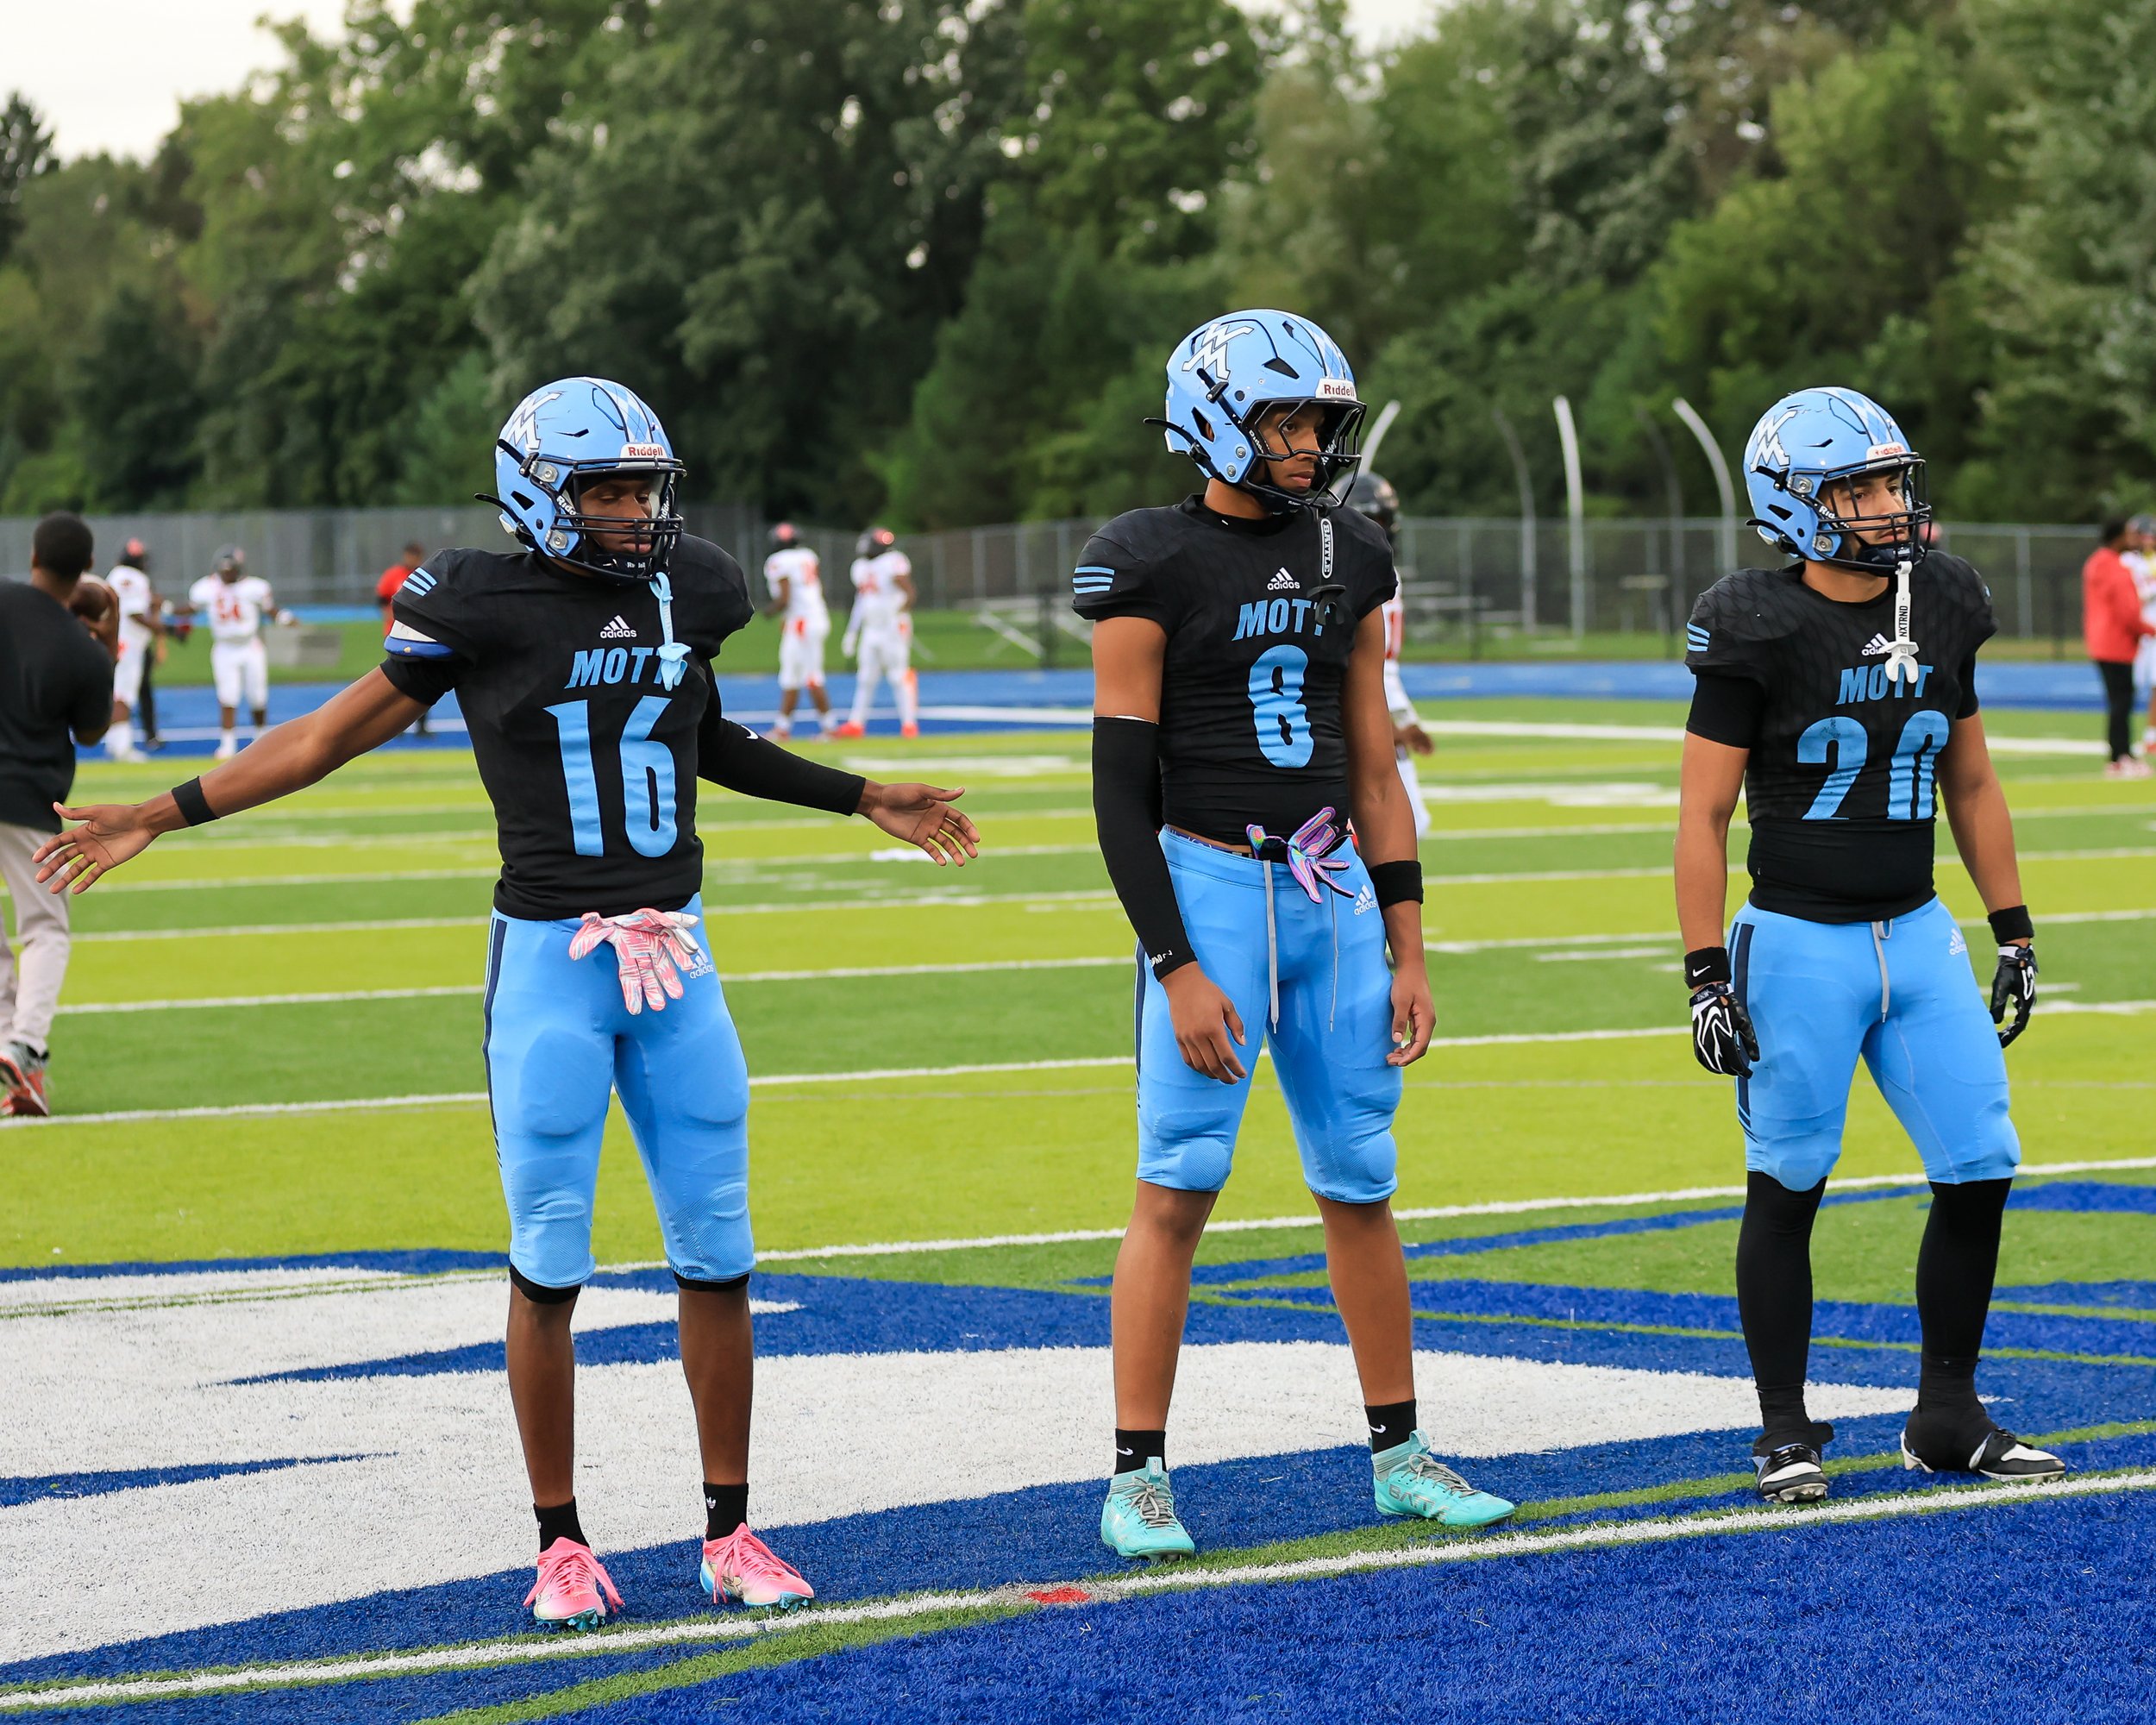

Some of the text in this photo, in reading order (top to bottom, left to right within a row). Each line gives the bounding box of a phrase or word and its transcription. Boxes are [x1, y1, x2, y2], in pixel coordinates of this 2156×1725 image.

[1324, 384, 1355, 398] Riddell
[628, 446, 663, 456] Riddell
[556, 495, 576, 516] Ridd
[1267, 579, 1300, 590] adidas
[1899, 605, 1908, 637] NXTRND
[600, 628, 637, 638] adidas
[1862, 644, 1891, 656] adi
[1248, 644, 1314, 768] 8
[1797, 710, 1949, 820] 20
[543, 695, 678, 857] 16
[1354, 900, 1377, 916] adidas
[690, 963, 714, 979] adidas
